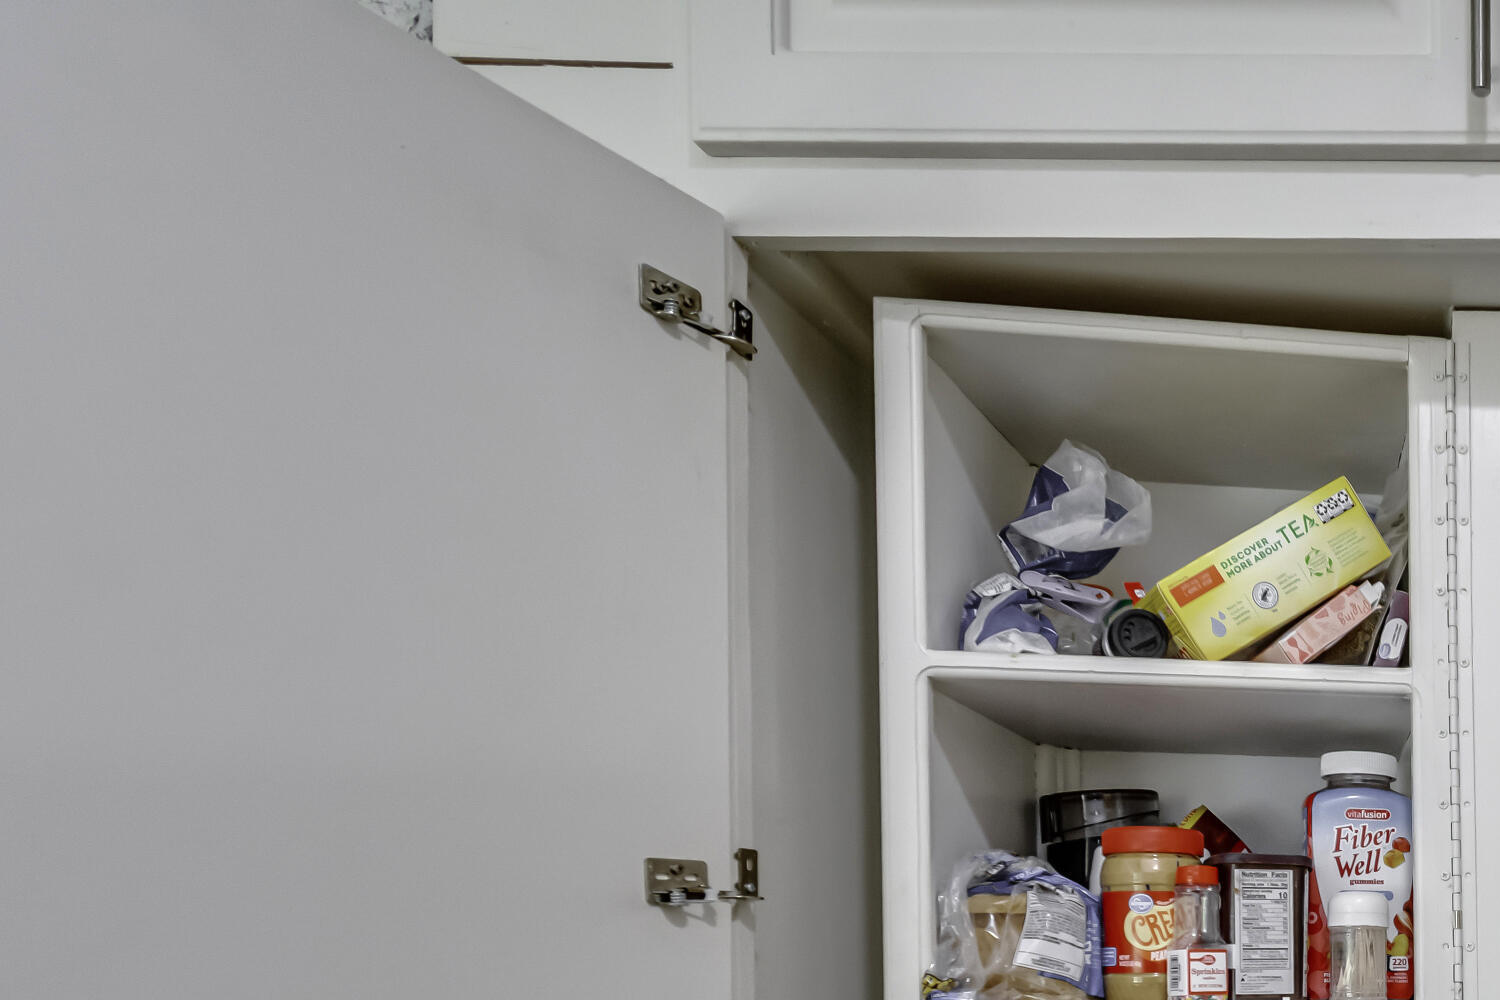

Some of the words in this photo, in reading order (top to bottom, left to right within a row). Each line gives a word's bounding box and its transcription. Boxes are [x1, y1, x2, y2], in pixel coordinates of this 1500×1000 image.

[1275, 513, 1320, 544] TEA
[1220, 537, 1269, 570] DISCOVER
[1225, 561, 1254, 579] MORE
[1254, 540, 1283, 564] ABOUT
[1347, 809, 1387, 819] vitafusion
[1332, 824, 1396, 853] Fiber
[1333, 848, 1382, 879] Well
[1392, 958, 1408, 966] 220
